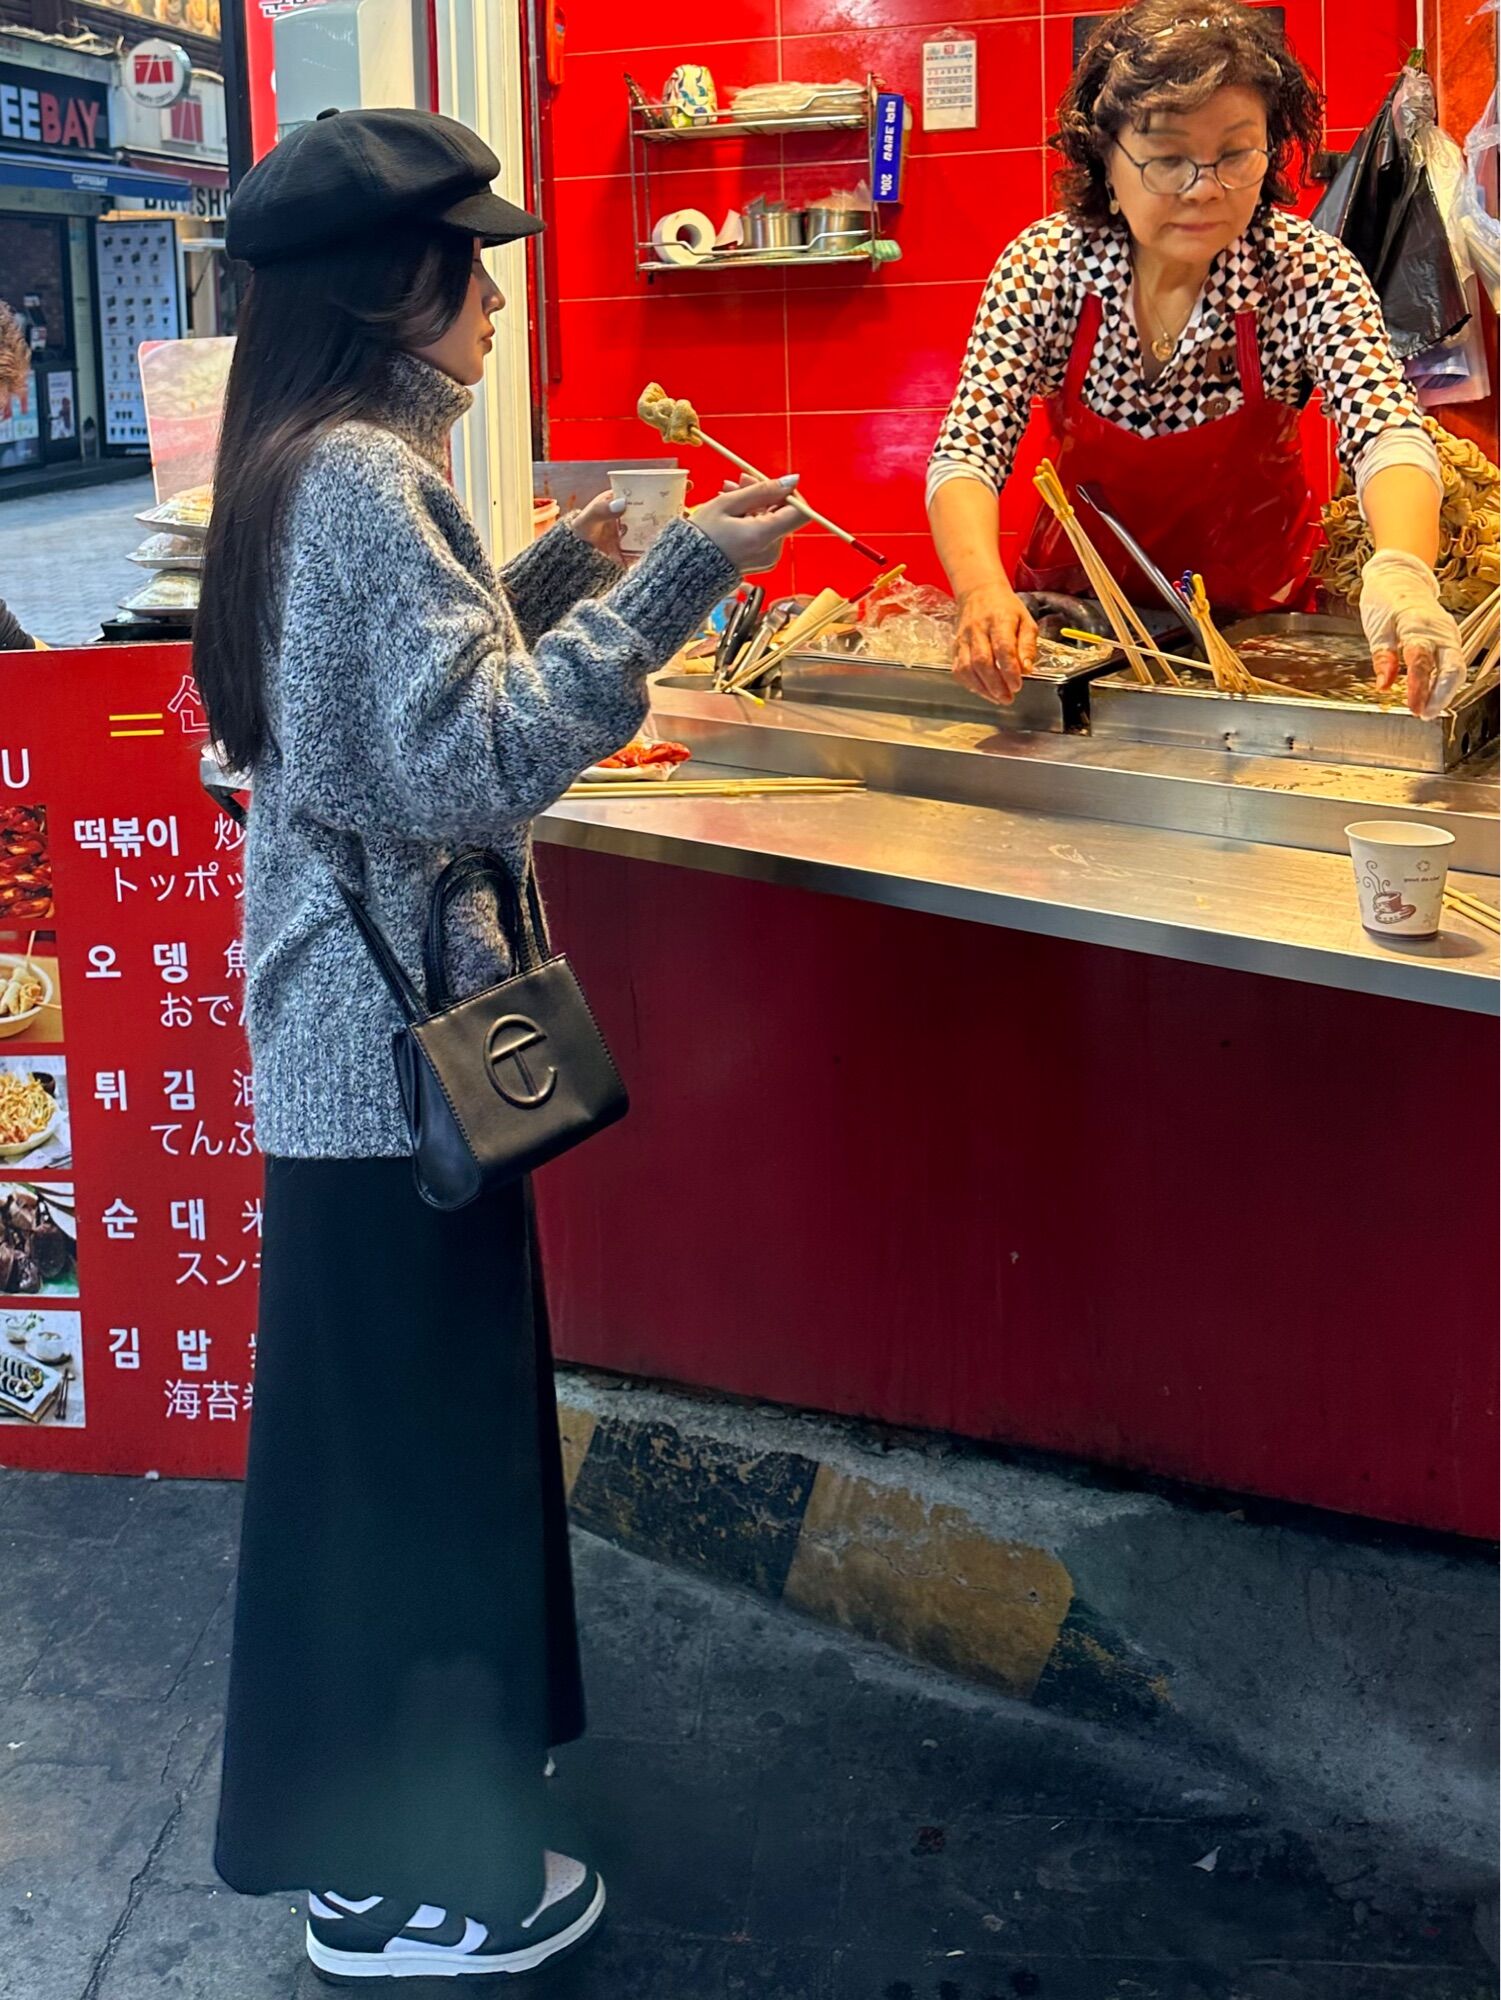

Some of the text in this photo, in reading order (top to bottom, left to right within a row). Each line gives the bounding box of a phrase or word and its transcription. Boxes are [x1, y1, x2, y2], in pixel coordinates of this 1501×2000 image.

[74, 815, 179, 858] 떡볶이
[85, 945, 122, 978] 오
[153, 942, 189, 984] 뎅
[160, 992, 246, 1027] おで
[94, 1069, 128, 1111] 튀
[163, 1069, 196, 1111] 김
[101, 1198, 138, 1239] 순
[170, 1198, 206, 1241] 대
[109, 1327, 140, 1369] 김
[177, 1329, 212, 1372] 밥
